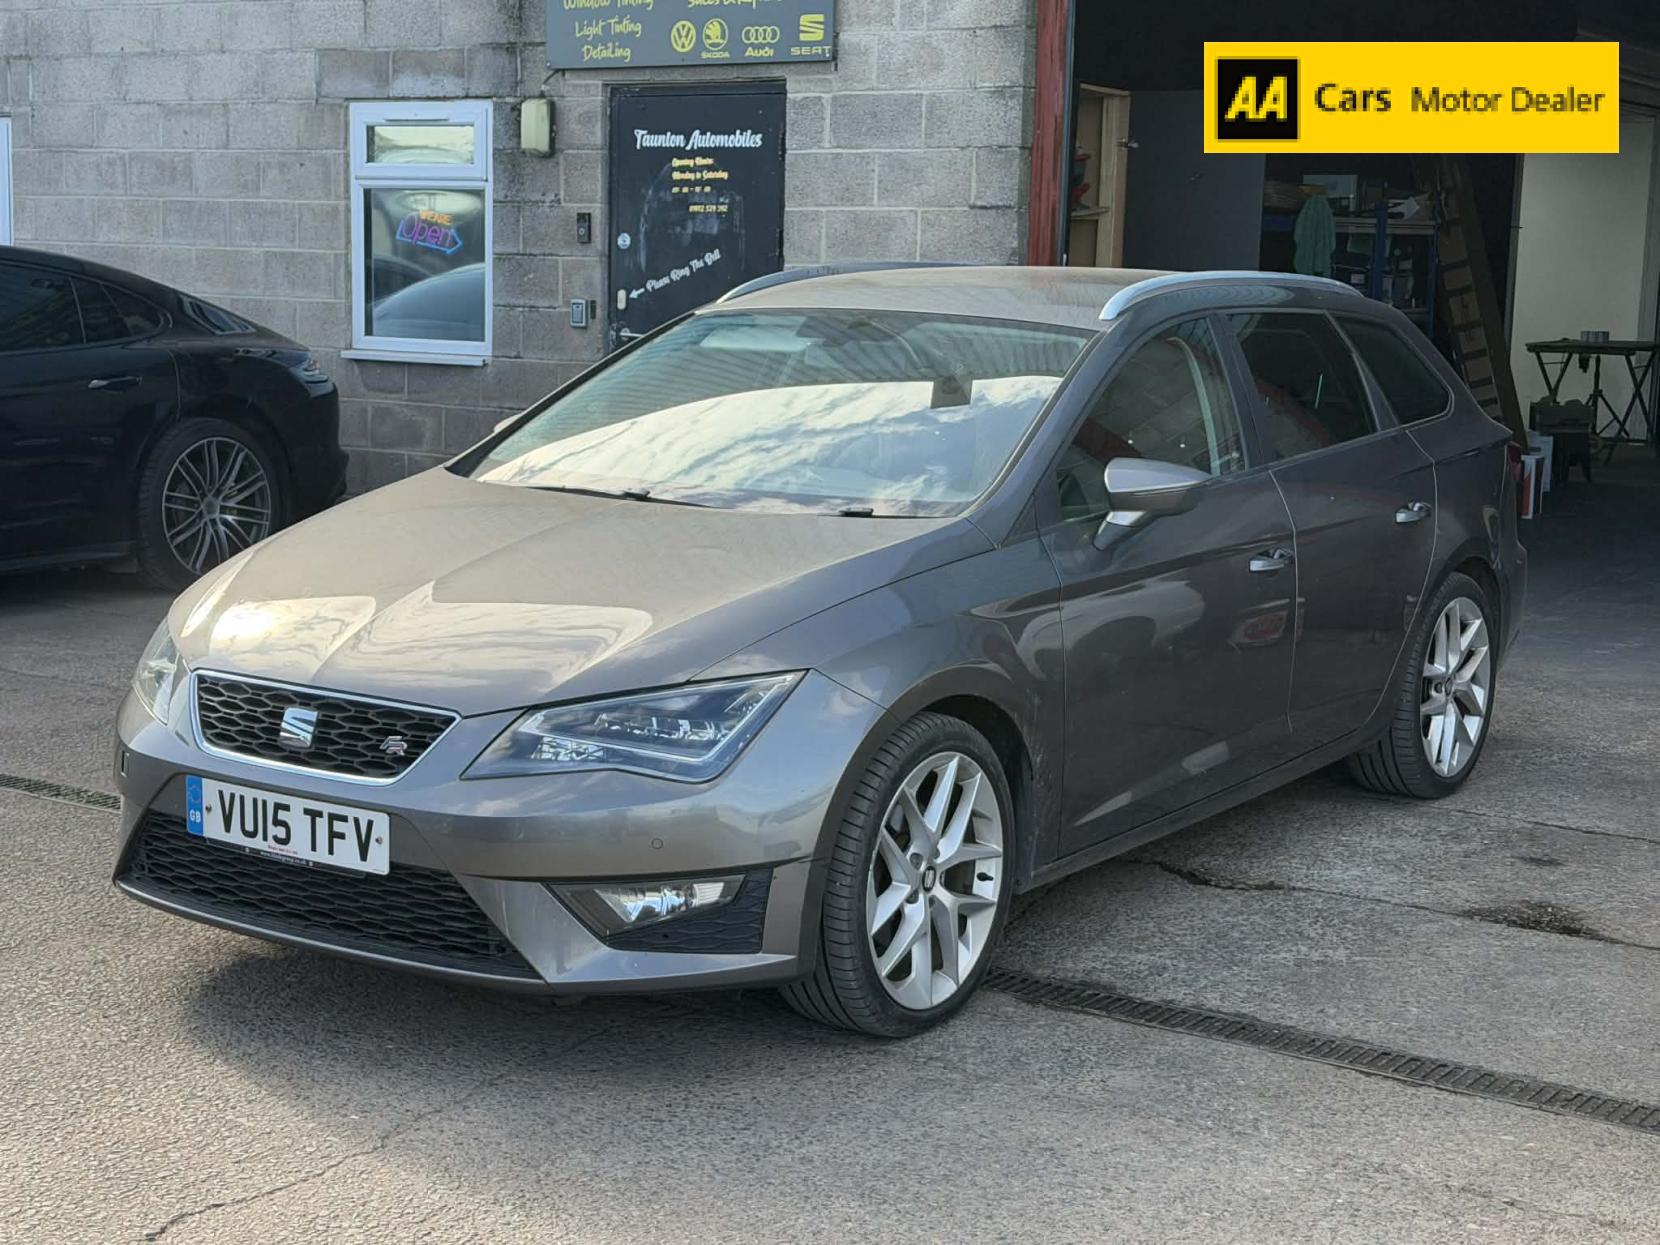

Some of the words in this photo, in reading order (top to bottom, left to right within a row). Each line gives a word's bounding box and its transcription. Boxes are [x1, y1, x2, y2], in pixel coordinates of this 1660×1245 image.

[575, 19, 606, 40] Light
[606, 15, 642, 37] Tinting
[581, 42, 632, 62] Detailing
[744, 46, 775, 57] Audi
[790, 46, 832, 56] SEAT
[634, 129, 686, 150] Taunton
[685, 129, 763, 151] Automobiles
[402, 212, 452, 246] Open
[646, 276, 671, 292] Please
[670, 266, 691, 281] Ring
[689, 258, 704, 272] The
[704, 248, 721, 266] Bell
[189, 808, 201, 823] GB
[218, 790, 291, 846] VU15
[303, 807, 374, 862] TFV
